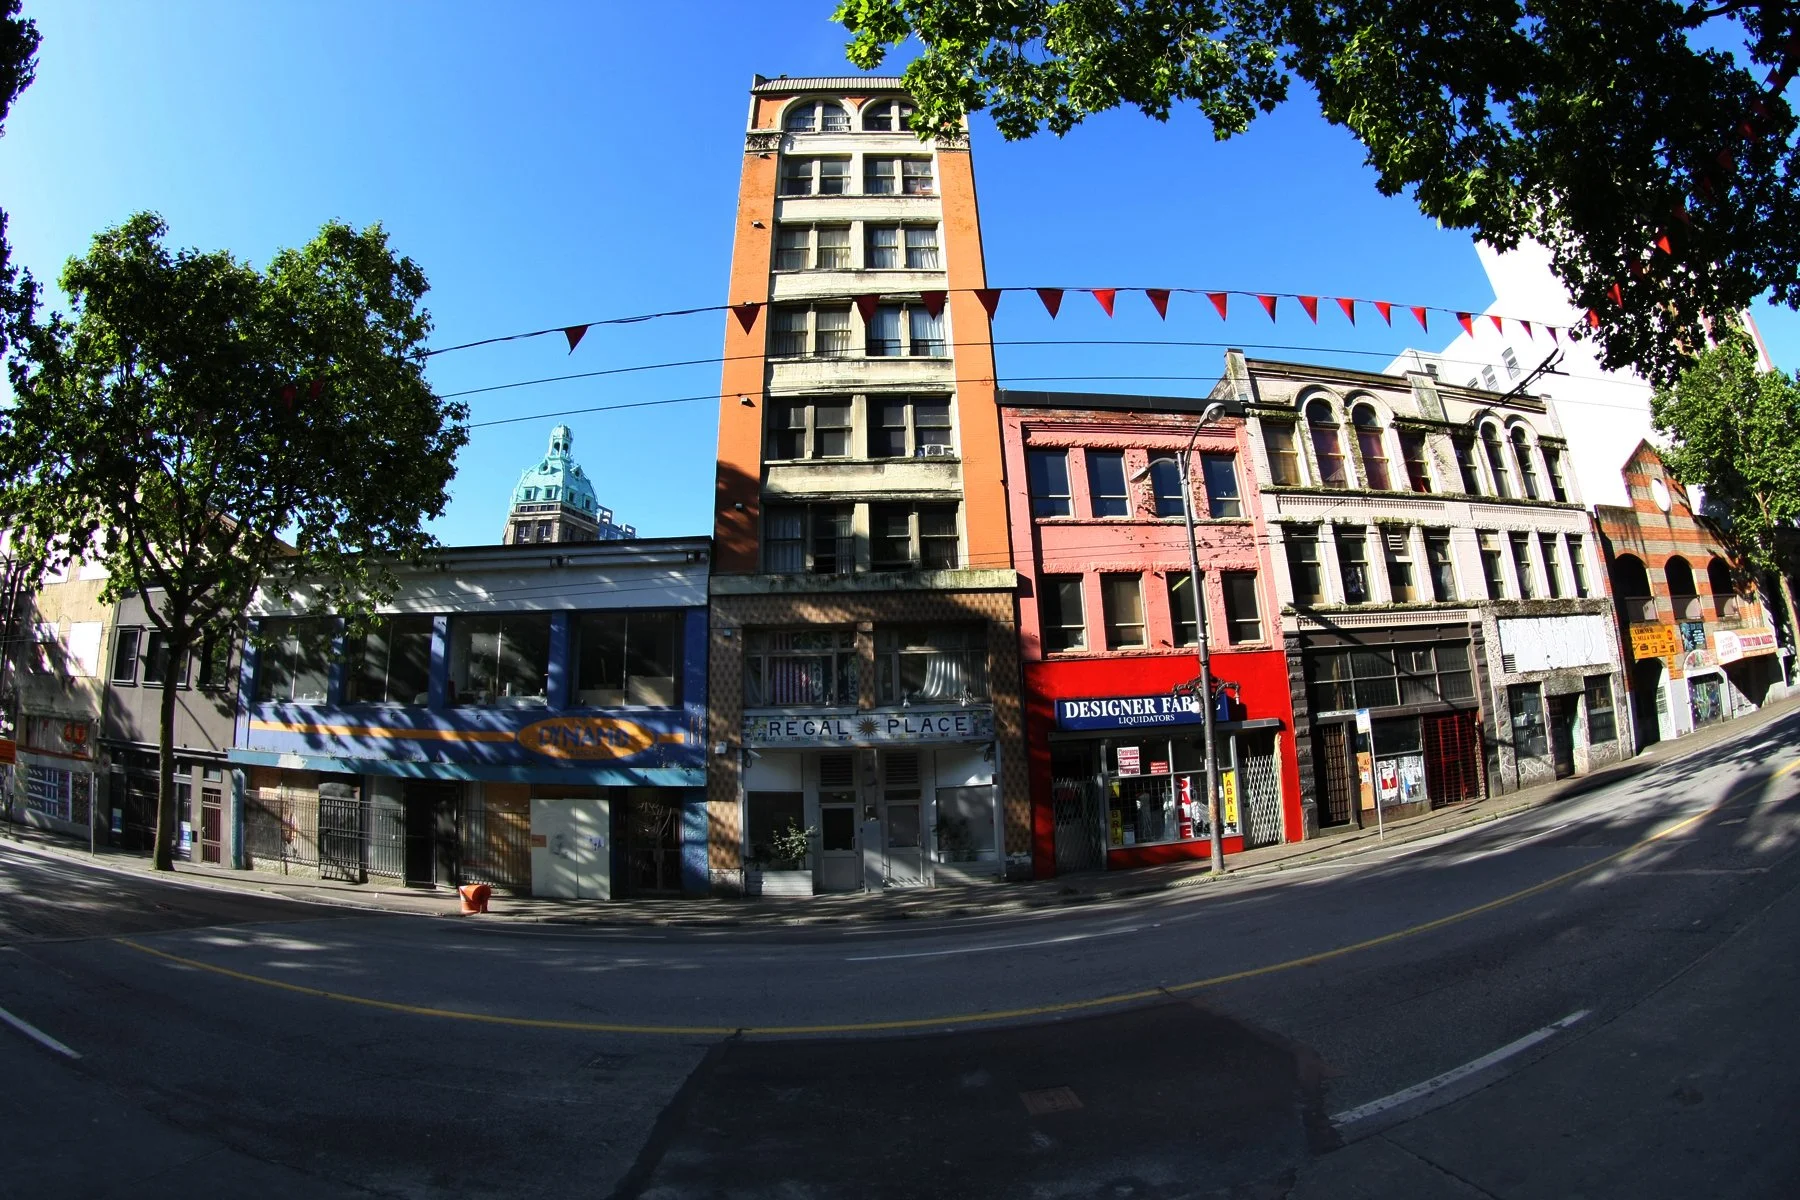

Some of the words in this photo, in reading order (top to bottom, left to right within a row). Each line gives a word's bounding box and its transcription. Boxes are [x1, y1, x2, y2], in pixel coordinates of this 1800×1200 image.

[1064, 697, 1157, 718] DESIGNER
[769, 719, 849, 736] REGAL
[886, 716, 968, 734] PLACE
[1118, 714, 1175, 725] LIQUIDATORS
[538, 724, 629, 747] DYNAMO
[1176, 775, 1192, 838] SALE
